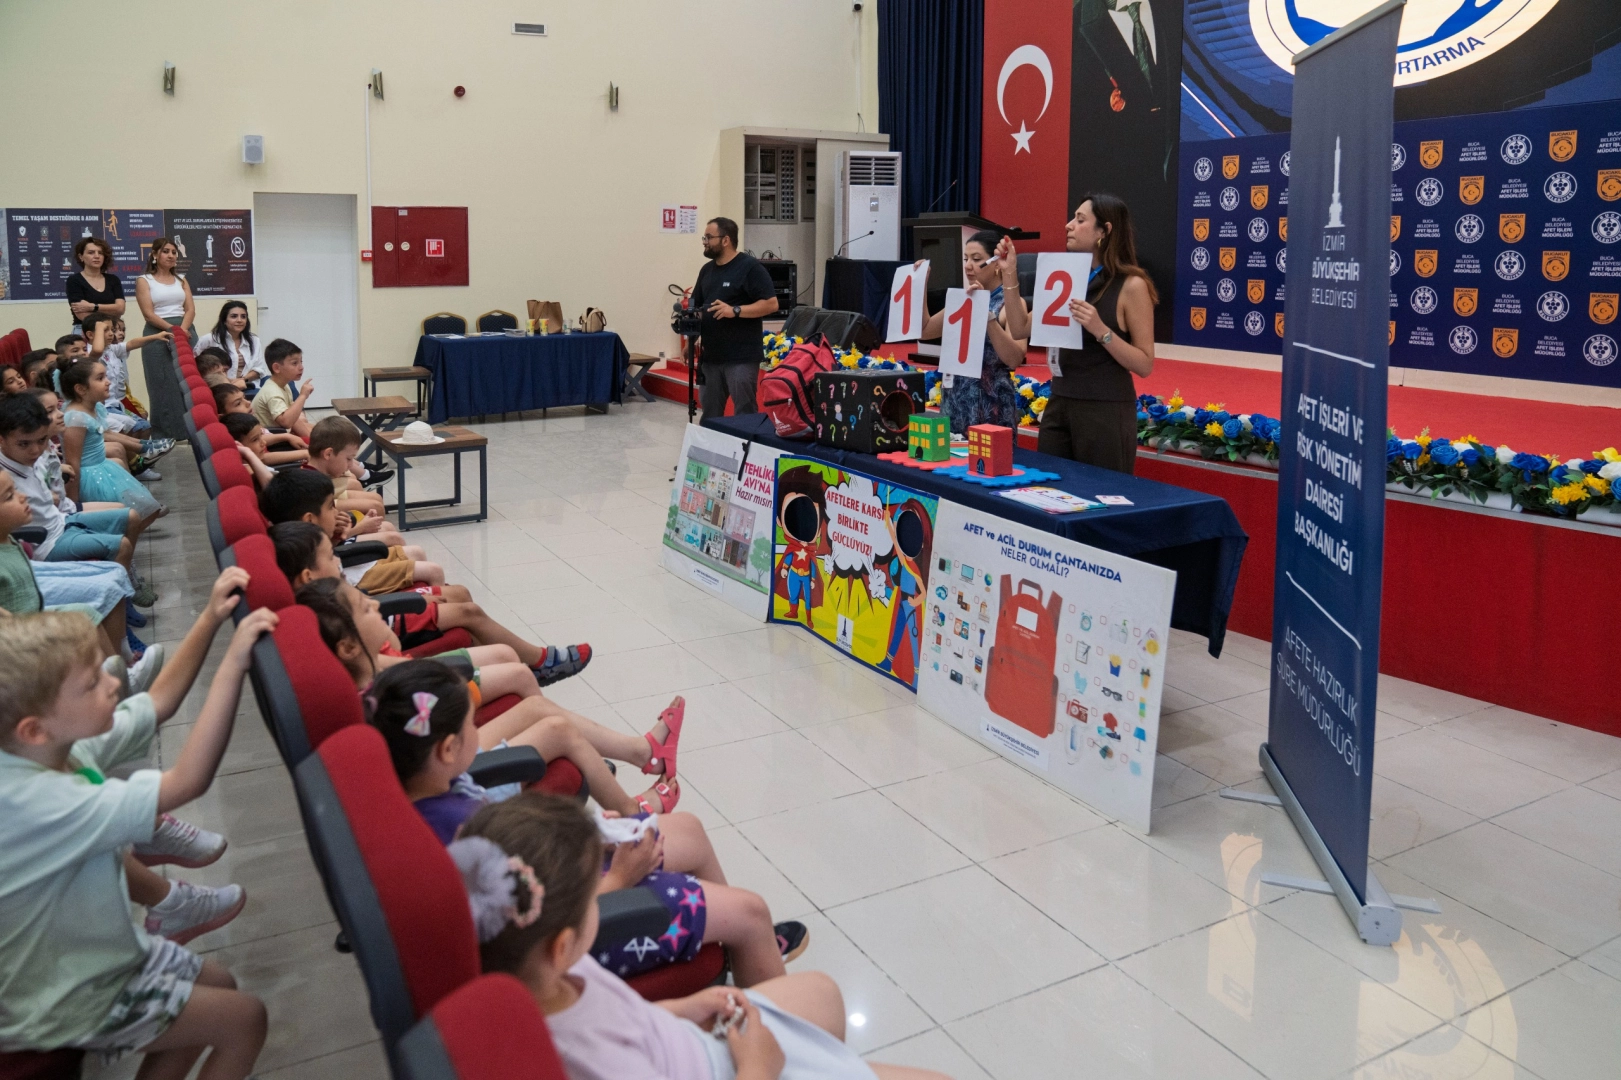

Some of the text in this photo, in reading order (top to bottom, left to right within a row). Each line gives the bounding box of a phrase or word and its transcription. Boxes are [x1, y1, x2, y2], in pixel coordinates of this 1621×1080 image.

[1395, 36, 1485, 75] RTARMA
[1322, 231, 1345, 251] İZMİR
[1312, 257, 1360, 283] BÜYÜKŞEHİR
[894, 274, 912, 335] 1
[1042, 270, 1072, 327] 2
[1312, 287, 1357, 309] BELEDİYESİ
[948, 298, 972, 364] 1
[1319, 396, 1350, 437] İŞLERİ
[1352, 416, 1364, 445] VE
[743, 476, 771, 495] AVI'NA
[1315, 440, 1362, 490] YÖNETİM
[735, 486, 753, 501] Hazır
[826, 491, 885, 521] AFETLERE KARŞI
[1306, 478, 1344, 523] DAİRESİ
[832, 531, 872, 556] GÜÇLÜYÜZ!
[838, 513, 869, 535] BİRLİKTE
[1295, 511, 1353, 575] BAŞKANLIĞI
[964, 522, 1122, 583] AFET ve ACİL DURUM ÇANTANIZDA
[1001, 546, 1069, 578] NELER OLMALI?
[1285, 626, 1358, 726] AFETE HAZIRLIK
[1277, 652, 1360, 776] ŞUBE MÜDÜRLÜĞÜ
